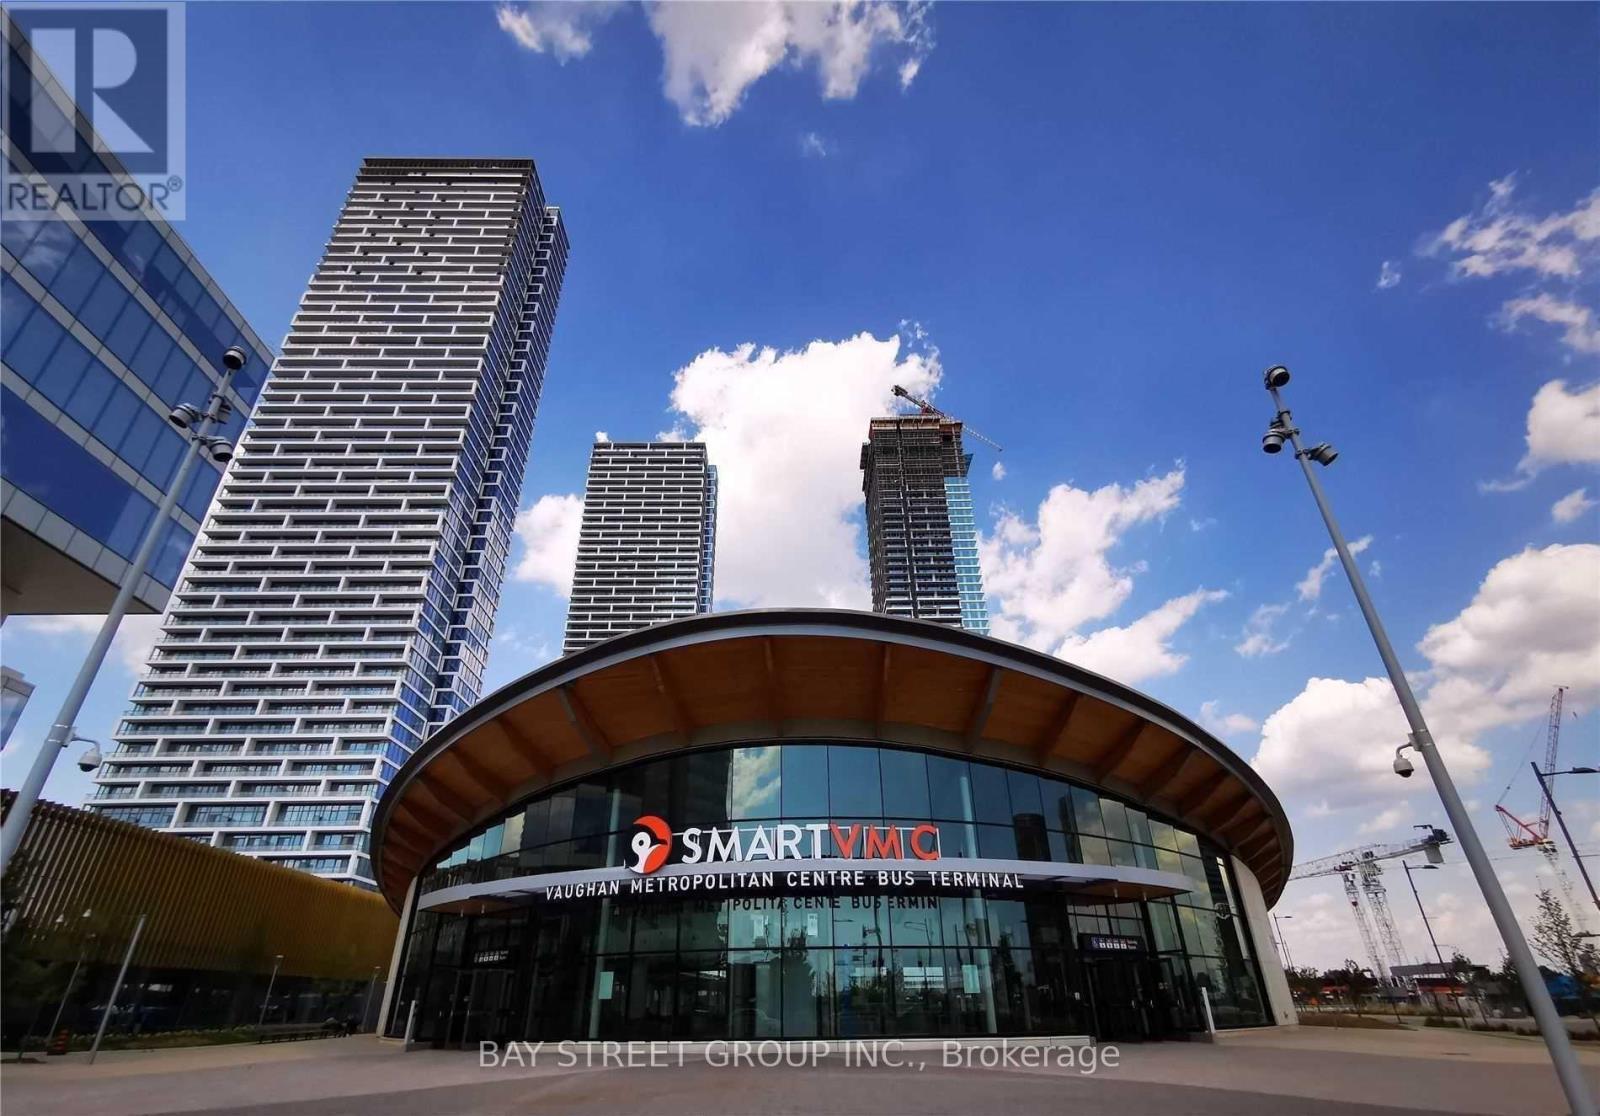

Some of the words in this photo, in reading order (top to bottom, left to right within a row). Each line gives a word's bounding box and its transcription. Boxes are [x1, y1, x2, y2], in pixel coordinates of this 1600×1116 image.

[546, 880, 620, 900] VAUGHAN
[631, 872, 774, 894] METROPOLITAN
[787, 871, 865, 887] CENTRE
[878, 871, 915, 886] BUS
[928, 871, 1024, 888] TERMINAL
